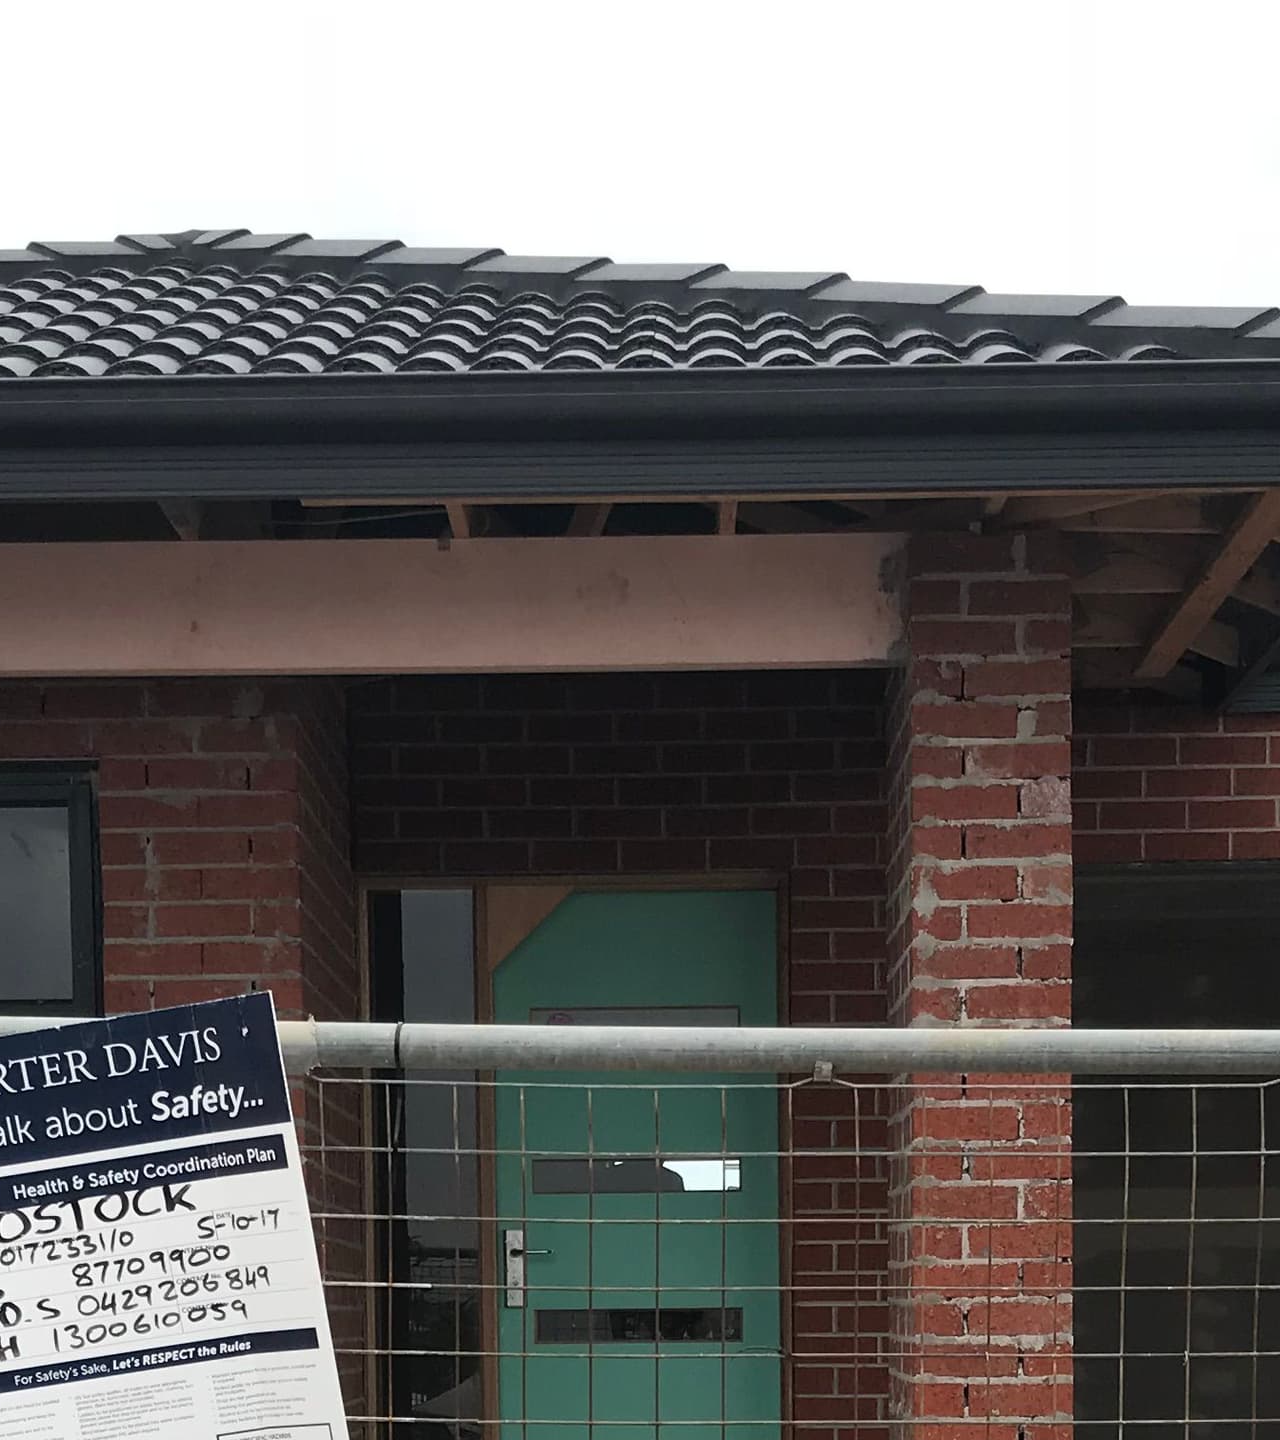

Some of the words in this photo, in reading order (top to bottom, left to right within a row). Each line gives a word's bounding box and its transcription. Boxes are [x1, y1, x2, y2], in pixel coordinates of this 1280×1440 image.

[102, 1027, 221, 1078] DAVIS
[45, 1098, 142, 1139] about
[151, 1083, 264, 1122] Safety...
[12, 1178, 69, 1200] Health
[71, 1174, 85, 1190] &
[87, 1168, 139, 1188] Safety
[143, 1151, 245, 1179] Coordination
[246, 1147, 276, 1164] Plan
[14, 1374, 33, 1386] For
[35, 1367, 79, 1383] Safety's
[80, 1363, 110, 1376] Sake,
[112, 1356, 141, 1370] Let's
[142, 1347, 196, 1366] RESPECT
[197, 1345, 217, 1357] the
[219, 1340, 252, 1354] Rules
